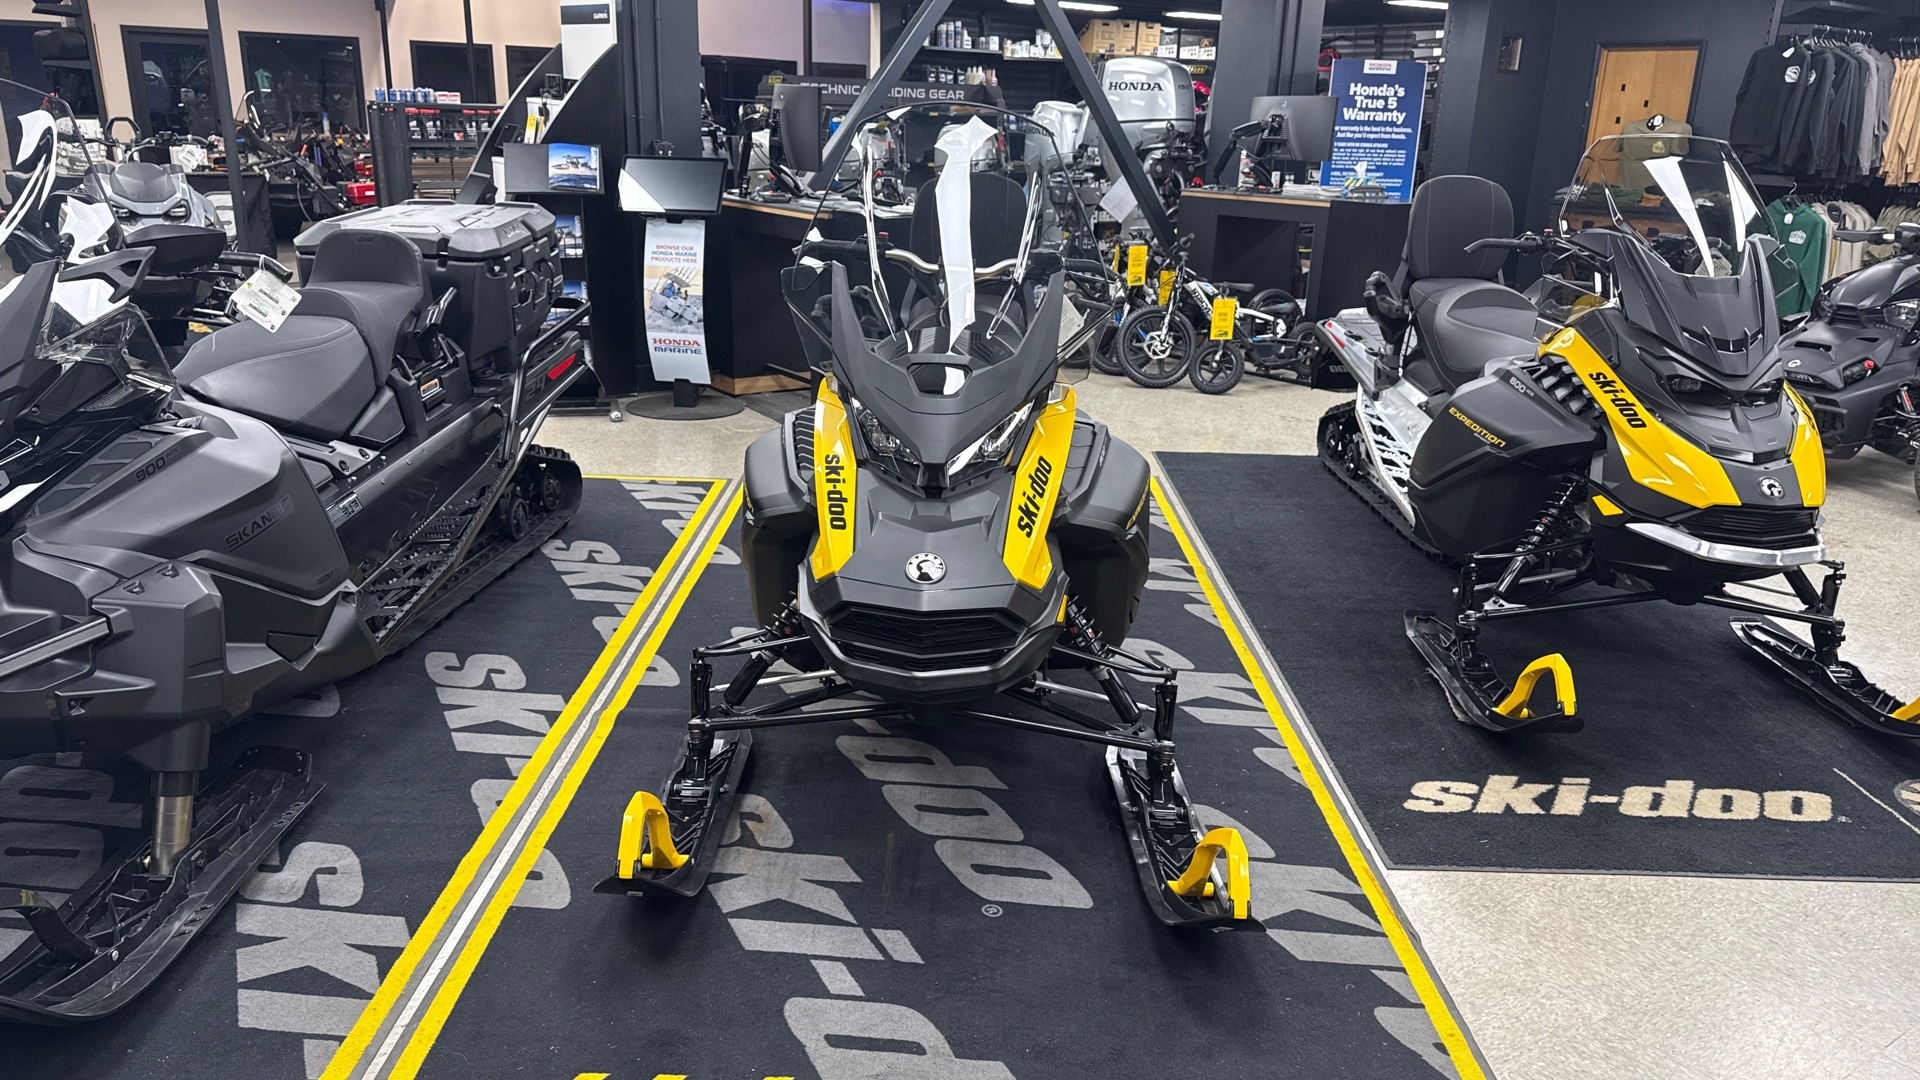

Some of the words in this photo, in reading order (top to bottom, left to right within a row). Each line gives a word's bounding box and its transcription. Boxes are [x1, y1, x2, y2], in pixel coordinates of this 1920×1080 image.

[888, 87, 925, 98] IDING
[929, 89, 964, 100] GEAR
[1108, 82, 1164, 91] HONDA
[1354, 96, 1385, 109] True
[1387, 97, 1397, 109] 5
[1342, 107, 1406, 124] Warranty
[652, 338, 701, 347] HONDA
[1509, 377, 1526, 393] 600
[1588, 370, 1648, 430] ski-doo
[1448, 406, 1506, 448] EXPEDITION
[135, 456, 166, 483] 900
[824, 453, 849, 531] ski-doo
[1016, 455, 1053, 539] ski-doo
[1402, 774, 1833, 822] ski-doo
